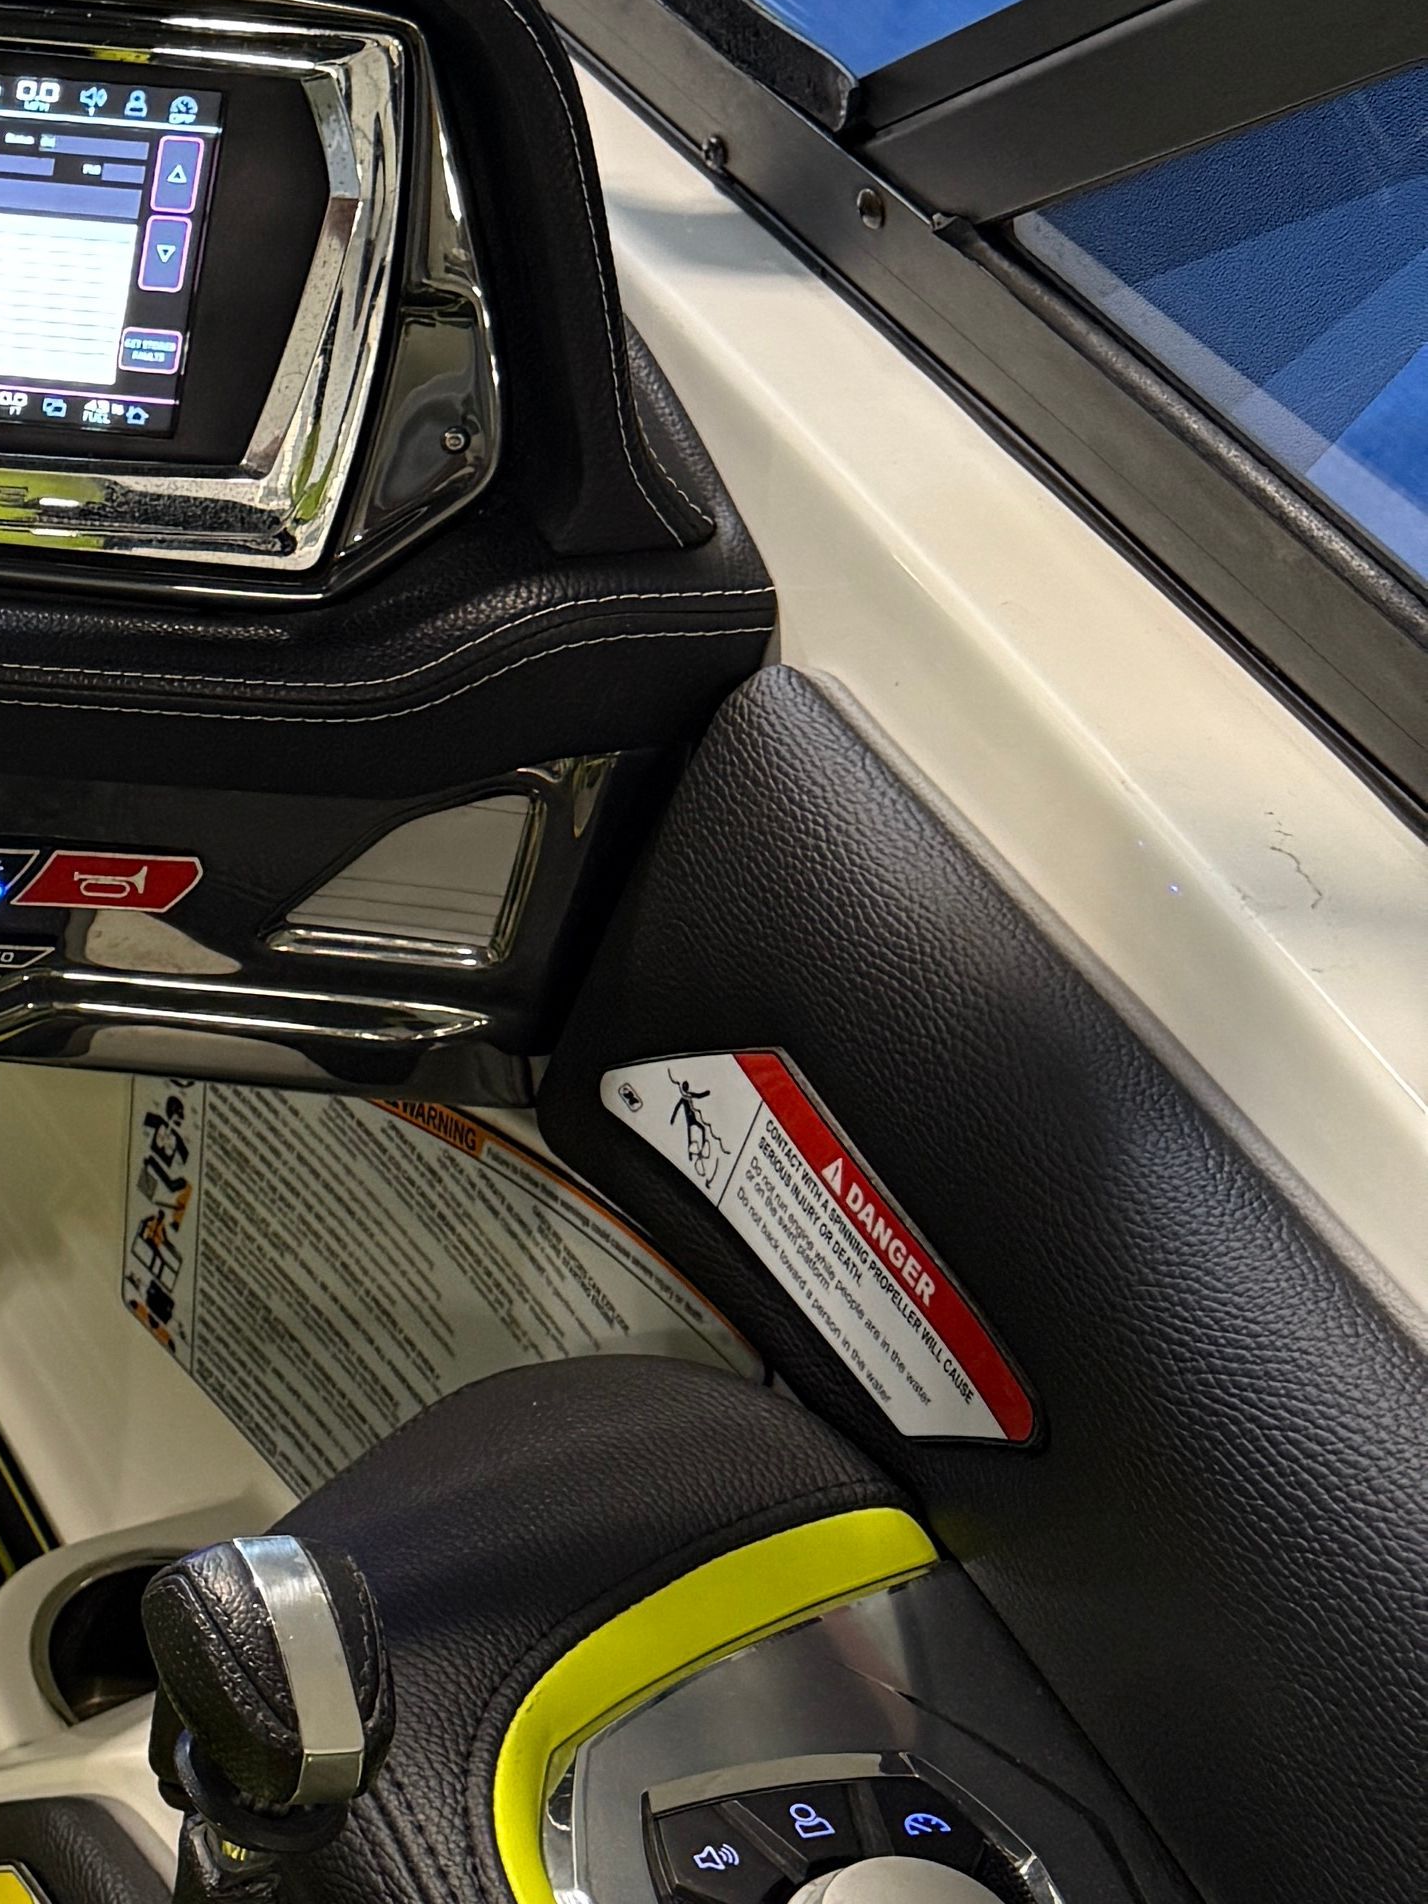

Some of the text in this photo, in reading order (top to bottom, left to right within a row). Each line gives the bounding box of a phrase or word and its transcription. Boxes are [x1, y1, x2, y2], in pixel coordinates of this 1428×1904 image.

[402, 1102, 476, 1151] WARNING
[753, 1180, 765, 1199] on
[764, 1195, 778, 1217] the
[776, 1213, 799, 1247] swim
[757, 1135, 793, 1188] SERIOUS
[789, 1182, 820, 1226] INJURY
[819, 1222, 833, 1245] OR
[844, 1182, 936, 1307] DANGER
[735, 1185, 750, 1208] Do
[748, 1204, 762, 1226] not
[761, 1222, 780, 1251] back
[778, 1249, 807, 1291] toward
[811, 1296, 841, 1340] person
[850, 1346, 867, 1372] the
[749, 1155, 763, 1177] Do
[761, 1172, 775, 1194] not
[774, 1192, 789, 1214] run
[787, 1211, 815, 1252] engine
[815, 1247, 838, 1281] while
[835, 1277, 865, 1321] people
[864, 1317, 880, 1340] are
[890, 1348, 907, 1374] the
[765, 1119, 975, 1405] CONTACT WITH A SPINNING PROPELLER WILL CAUSE
